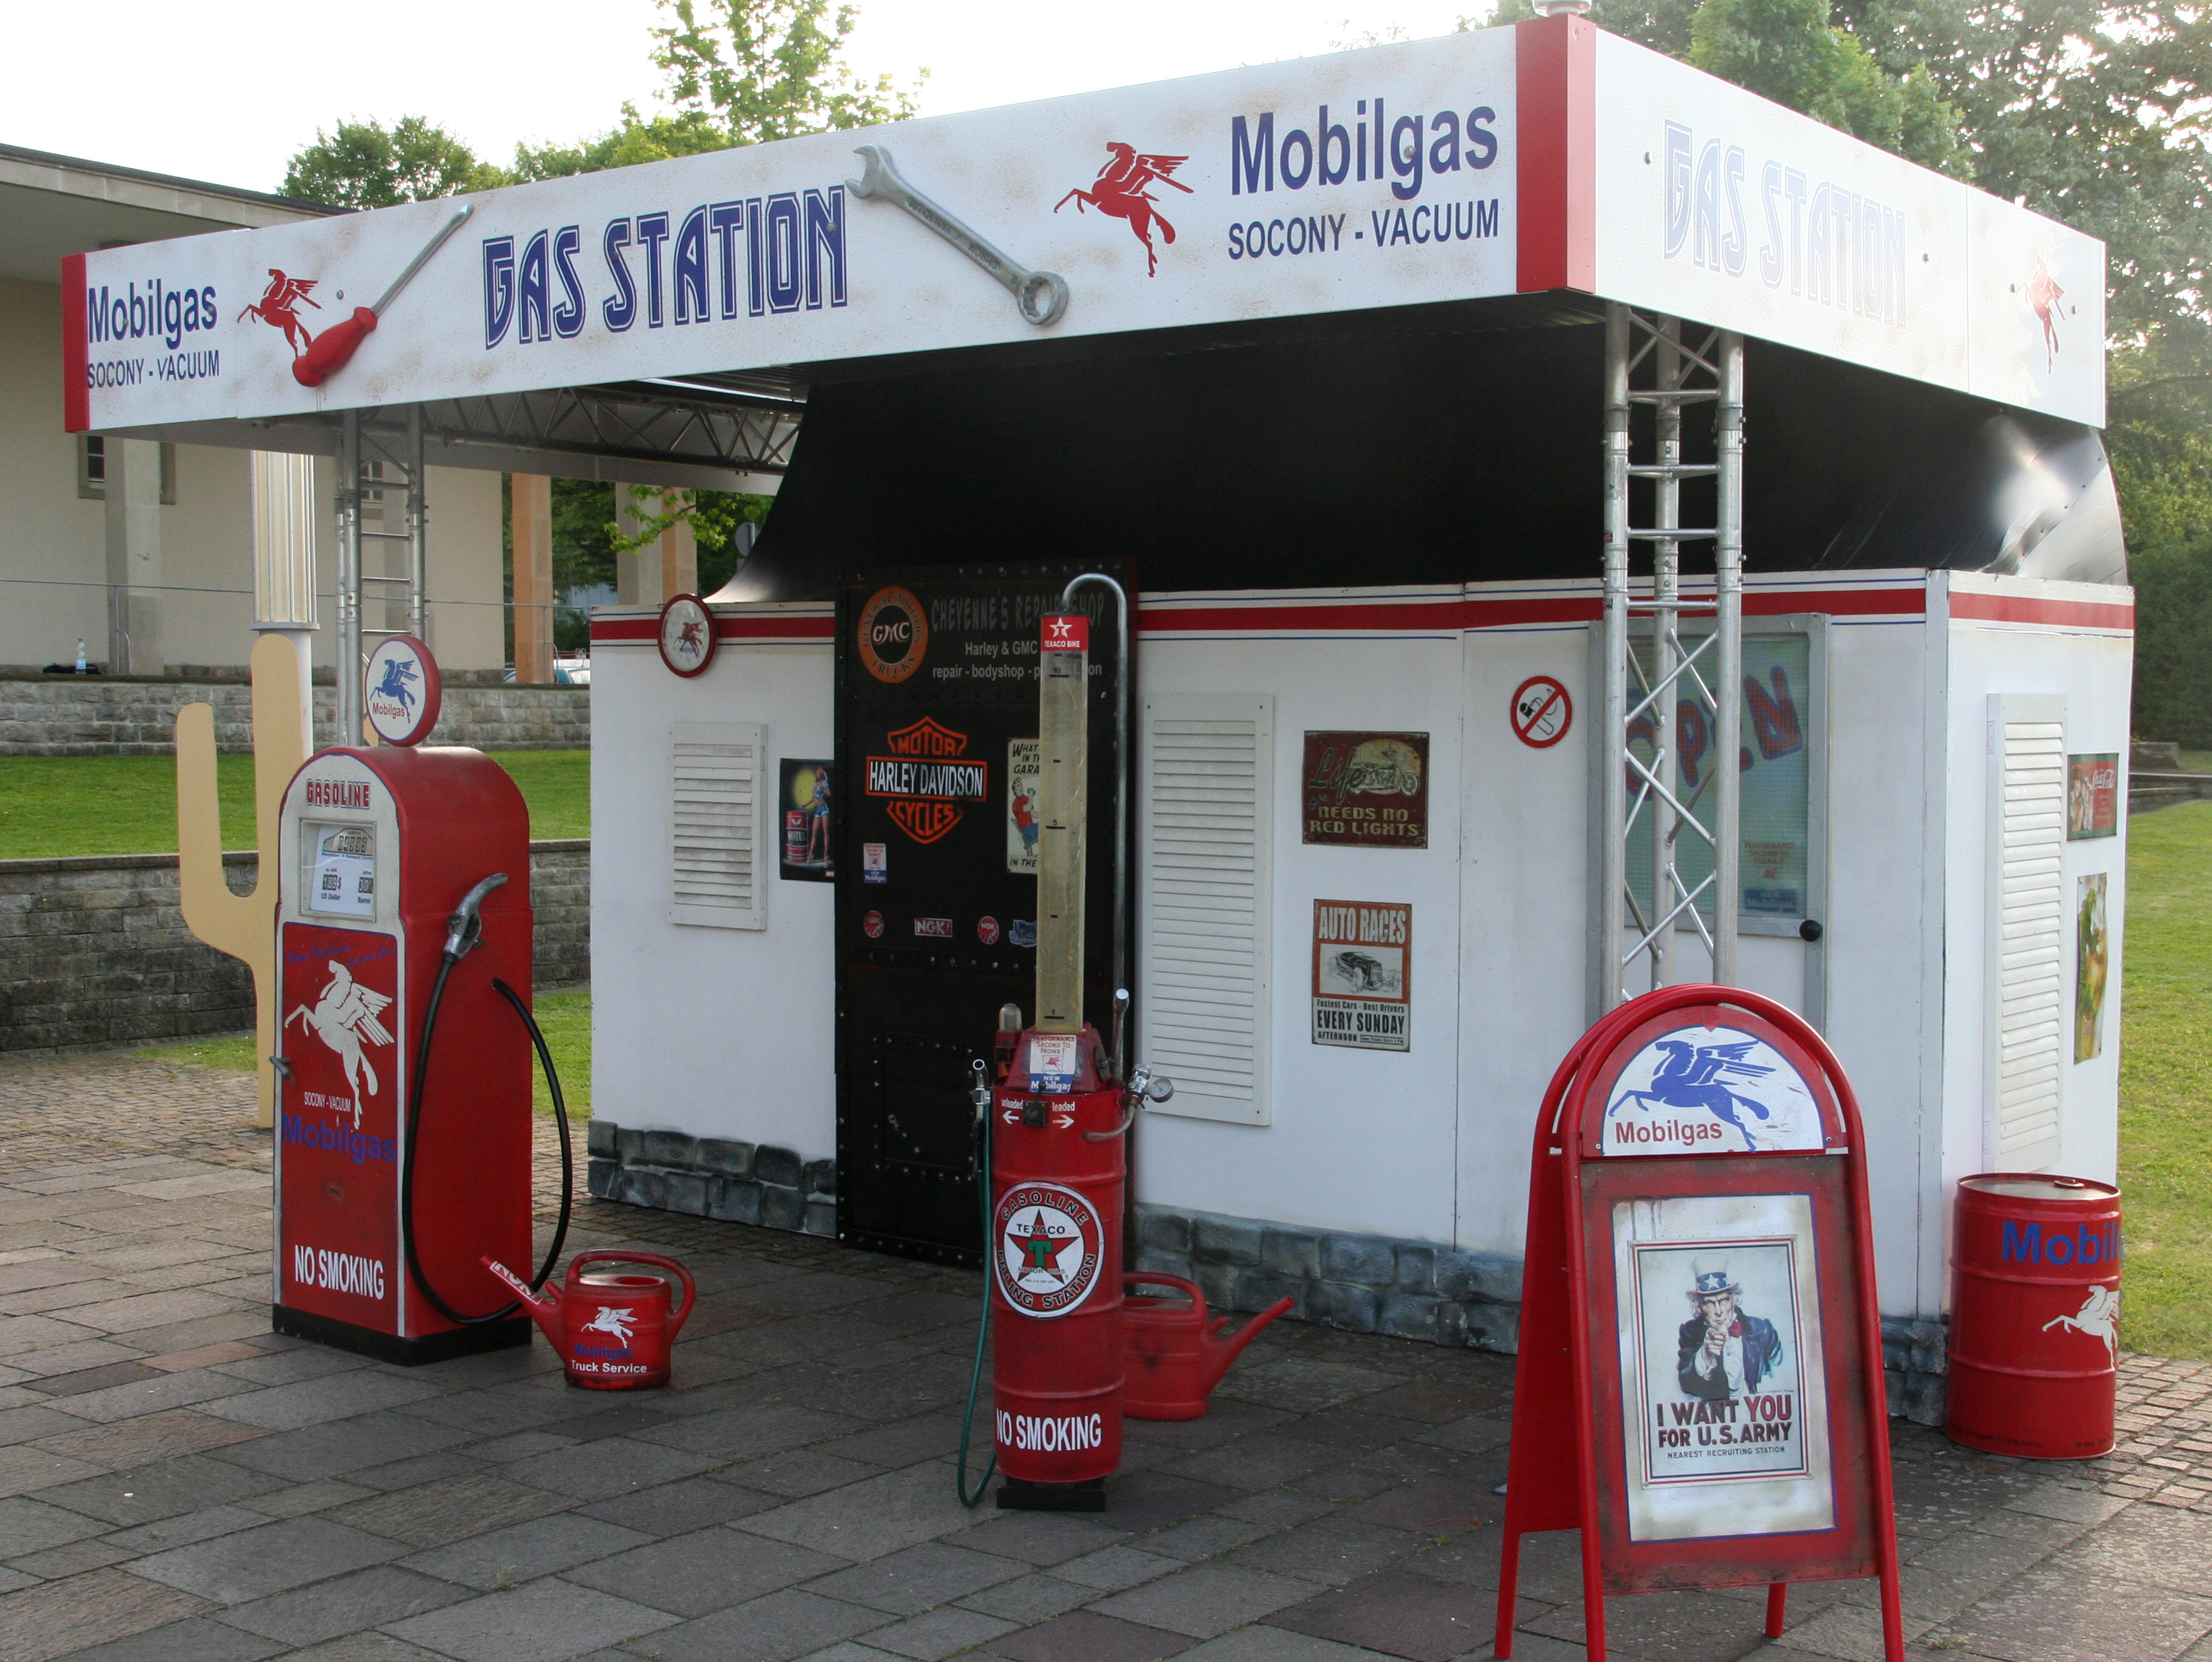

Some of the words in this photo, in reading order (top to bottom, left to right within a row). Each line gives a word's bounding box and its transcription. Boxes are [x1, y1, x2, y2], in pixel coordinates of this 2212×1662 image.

[1232, 97, 1498, 200] Mobilgas
[1228, 214, 1346, 259] SOCONY
[1371, 198, 1499, 247] VACUUM
[1664, 119, 1747, 278] GAS
[1759, 159, 1907, 330] STATION
[483, 224, 587, 350] GAS
[603, 185, 848, 333] STATION
[88, 278, 217, 350] Mobilgas
[87, 358, 144, 389] SOCONY
[157, 350, 220, 382] VACUUM
[872, 621, 910, 643] GMC
[965, 641, 999, 659] Harley
[1001, 641, 1009, 656] &
[1012, 641, 1038, 656] GMC
[872, 655, 916, 677] TRUCKS
[933, 664, 962, 680] repair
[972, 664, 1024, 681] bodyshop
[372, 702, 405, 719] Mobilgas
[897, 725, 957, 755] MOTOR
[1626, 665, 1803, 802] OPN
[1012, 743, 1039, 757] WHAT
[869, 761, 916, 793] HARLEY
[920, 765, 983, 797] DAVIDSON
[1014, 765, 1040, 775] GARA
[1307, 747, 1366, 806] Life
[306, 778, 371, 809] GASOLINE
[894, 801, 955, 837] CYCLES
[1308, 820, 1346, 833] RED
[1351, 822, 1419, 837] LIGHTS
[1021, 858, 1037, 868] THE
[916, 920, 946, 934] NGK
[1319, 906, 1356, 941] AUTO
[1359, 907, 1406, 944] RACES
[1317, 999, 1340, 1008] Fastest
[1343, 1001, 1358, 1009] Cars
[1363, 1002, 1378, 1011] Best
[1379, 1003, 1405, 1013] Drivers
[1317, 1010, 1353, 1031] EVERY
[1356, 1012, 1405, 1034] SUNDAY
[1317, 1031, 1358, 1042] AFTERNOON
[1031, 1080, 1071, 1093] Mbilgas
[304, 1091, 326, 1109] SOCONY
[329, 1094, 351, 1112] VACUUM
[1001, 1097, 1024, 1110] unleaded
[1052, 1101, 1076, 1112] leaded
[281, 1113, 397, 1164] Mobilgas
[1615, 1119, 1723, 1146] Mobilgas
[1001, 1191, 1089, 1226] GASOLINE
[1017, 1223, 1066, 1235] TEXACO
[2002, 1220, 2124, 1268] Mobil
[294, 1244, 315, 1285] NO
[318, 1249, 385, 1299] SMOKING
[997, 1249, 1034, 1307] FILLING
[1043, 1253, 1097, 1309] STATION
[574, 1342, 633, 1361] Mobilgas
[570, 1359, 599, 1372] Truck
[602, 1362, 647, 1373] Service
[1656, 1403, 1664, 1427] I
[1670, 1398, 1739, 1426] WANT
[1744, 1394, 1792, 1423] YOU
[996, 1407, 1012, 1446] NO
[1016, 1412, 1102, 1452] SMOKING
[1658, 1428, 1691, 1448] FOR
[1667, 1450, 1703, 1459] NEAREST
[1707, 1447, 1753, 1458] RECRUITING
[1755, 1446, 1786, 1454] STATION
